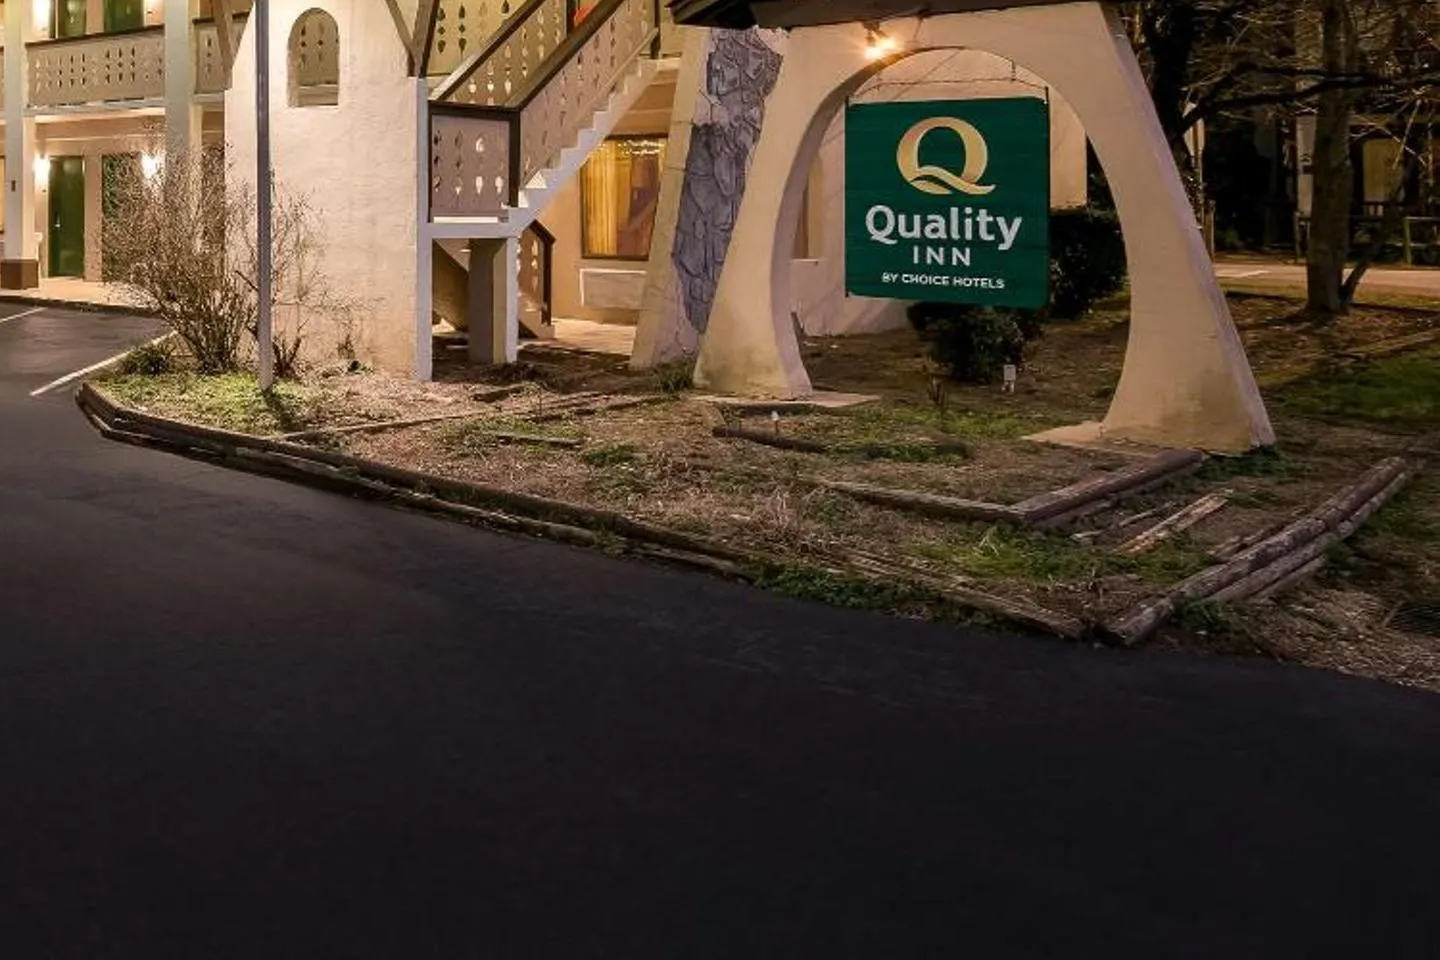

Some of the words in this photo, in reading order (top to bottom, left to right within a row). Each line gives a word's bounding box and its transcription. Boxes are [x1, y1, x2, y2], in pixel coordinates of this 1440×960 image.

[896, 116, 996, 195] Q
[865, 204, 1023, 251] Quality
[912, 245, 971, 267] INN
[881, 272, 899, 283] BY
[901, 273, 949, 286] CHOICE
[953, 276, 1005, 289] HOTELS
